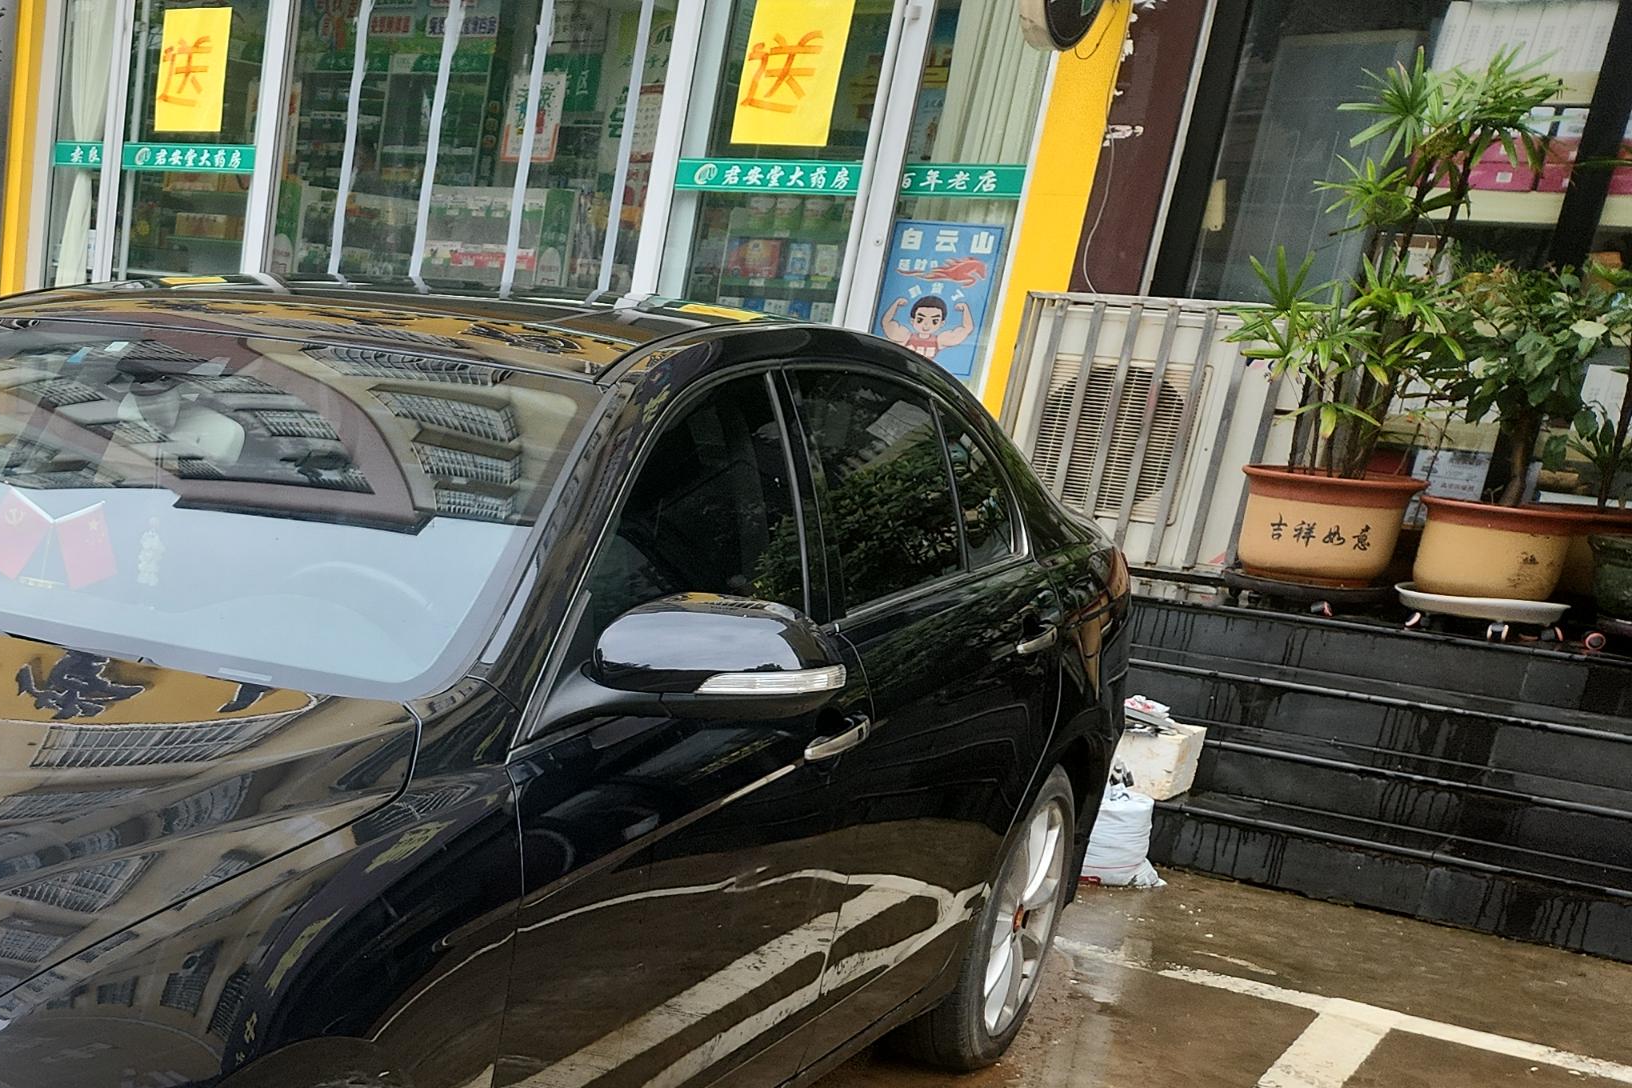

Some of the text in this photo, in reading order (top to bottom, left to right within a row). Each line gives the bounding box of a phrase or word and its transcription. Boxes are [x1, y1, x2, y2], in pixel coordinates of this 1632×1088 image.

[158, 35, 213, 107] 送
[740, 29, 823, 113] 送
[154, 147, 242, 169] 君安堂大药房
[722, 165, 850, 190] 君安堂大药房
[900, 227, 995, 254] 白云山
[1271, 512, 1371, 551] 吉祥如意
